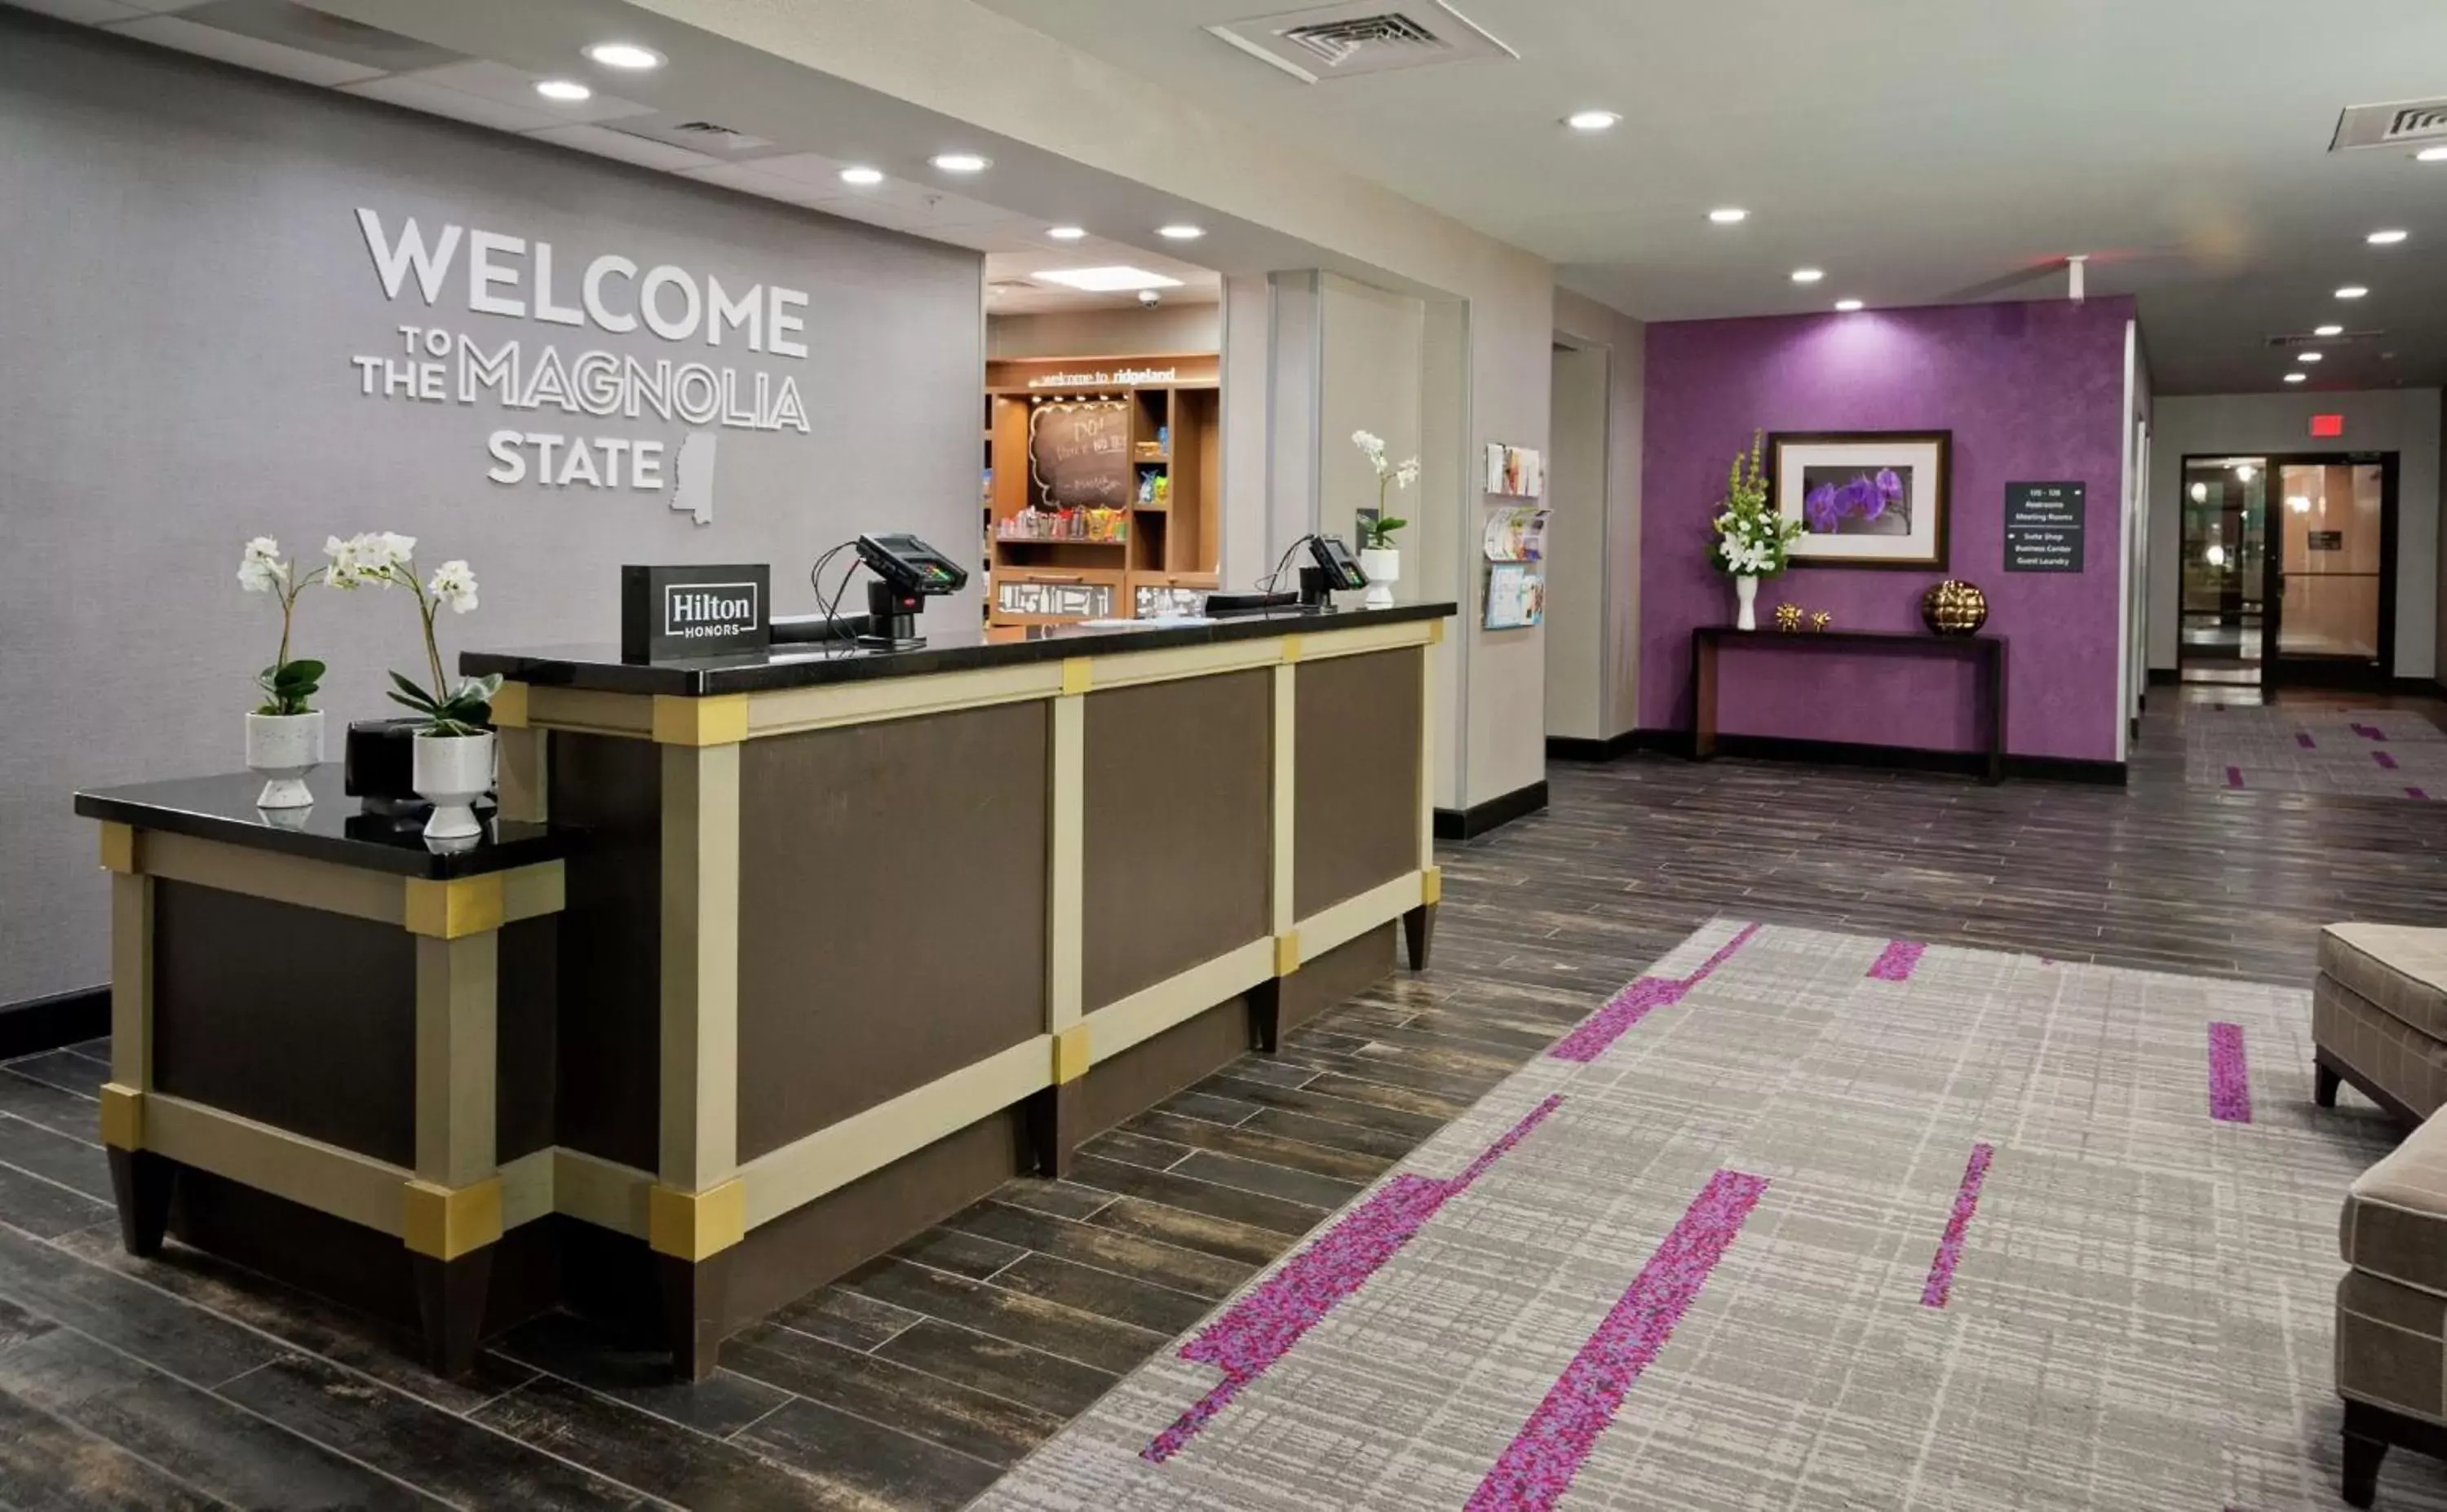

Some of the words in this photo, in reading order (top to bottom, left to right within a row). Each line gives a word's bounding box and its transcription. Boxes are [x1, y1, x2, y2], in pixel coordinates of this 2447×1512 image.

[354, 207, 809, 359] WELCOME
[398, 325, 452, 356] TO
[352, 355, 447, 400] THE
[458, 333, 811, 434] MAGNOLIA
[1113, 368, 1175, 386] ridgeland
[487, 430, 665, 489] STATE
[2039, 557, 2070, 567] Laundry
[673, 593, 750, 622] Hilton
[685, 623, 740, 639] HONORS
